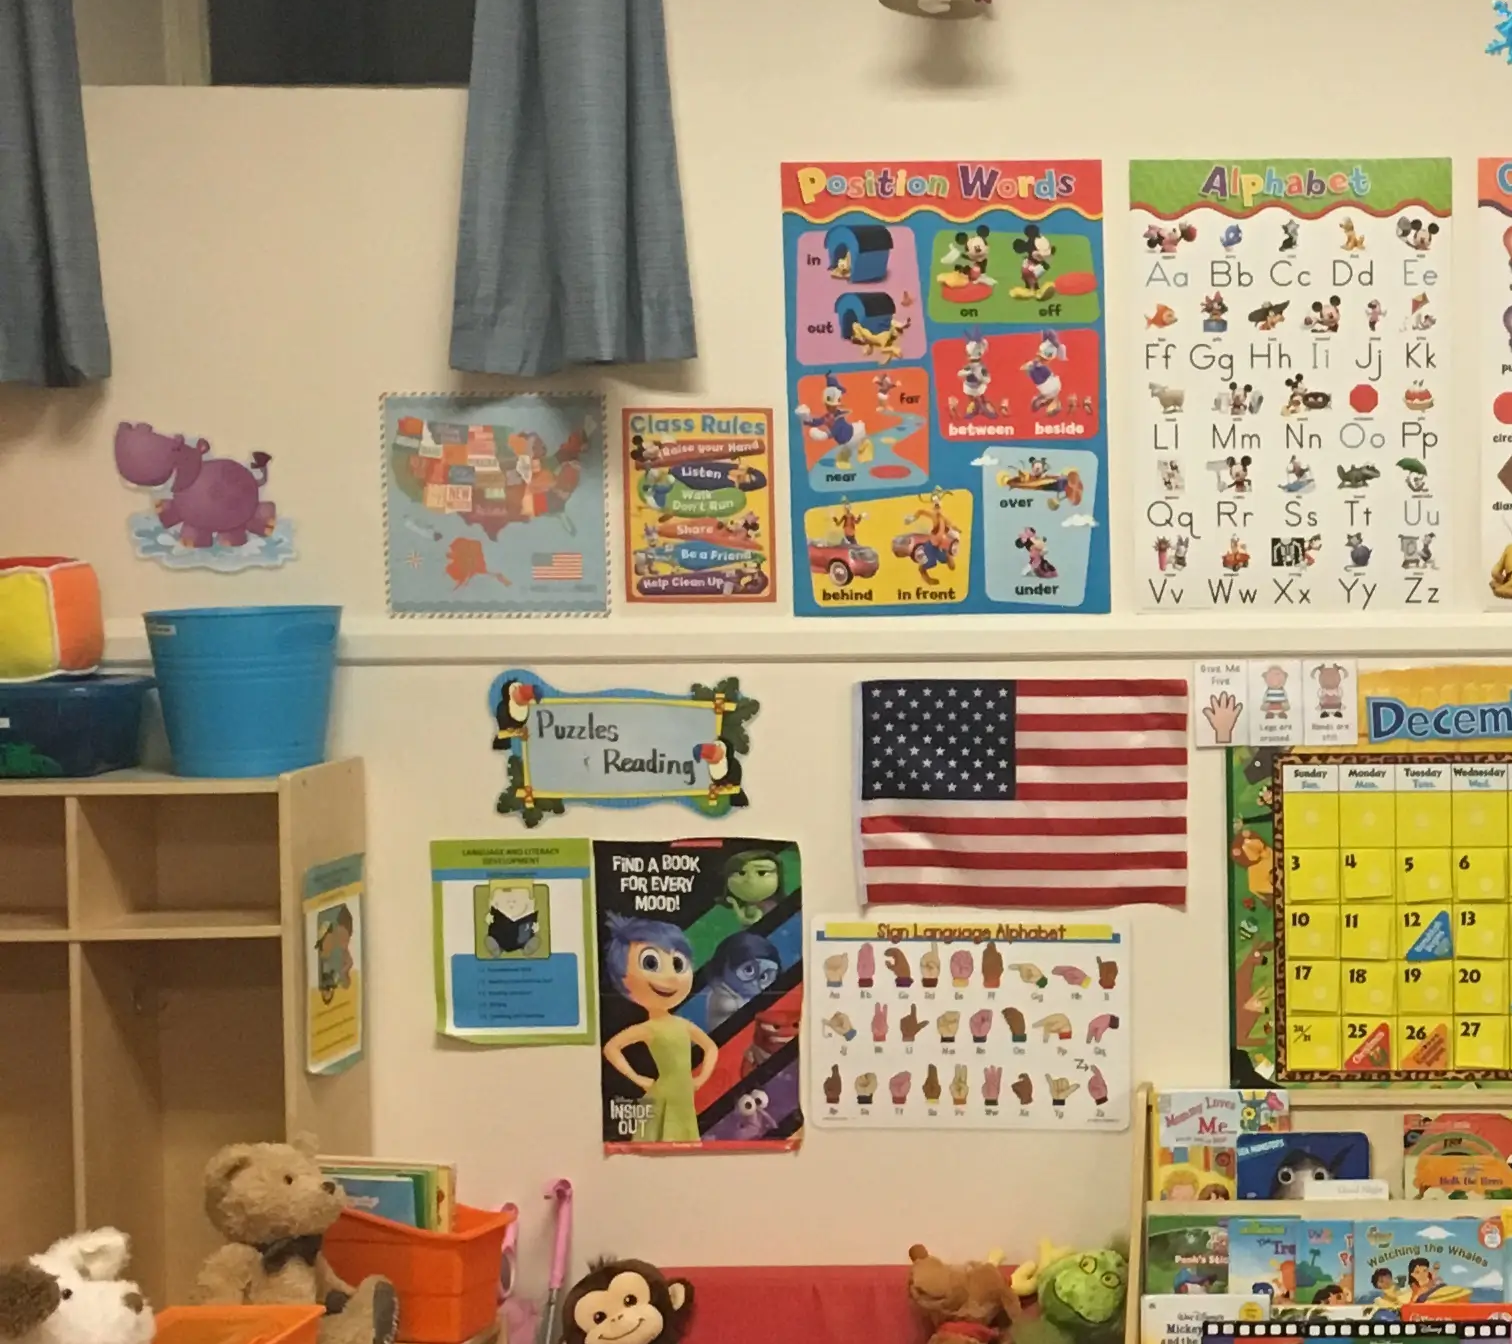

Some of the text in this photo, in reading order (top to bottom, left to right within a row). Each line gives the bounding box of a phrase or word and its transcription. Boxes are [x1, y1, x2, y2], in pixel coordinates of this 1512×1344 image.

[798, 164, 1074, 203] Position Words
[1202, 164, 1371, 206] Alphabet
[807, 253, 820, 265] in
[1145, 263, 1189, 288] Aa
[1212, 261, 1254, 287] Bb
[960, 306, 978, 317] on
[1039, 303, 1061, 317] off
[807, 322, 833, 333] out
[1190, 343, 1234, 379] Gg
[1405, 342, 1437, 368] Kk
[899, 392, 921, 403] far
[631, 415, 765, 435] Class Rules
[948, 422, 1014, 436] between
[1034, 422, 1084, 435] beside
[663, 441, 759, 456] Raise your Hand
[682, 467, 721, 479] Listen
[826, 472, 856, 482] near
[682, 490, 711, 500] Walk
[672, 499, 733, 512] Don't Run
[1000, 498, 1033, 509] over
[1217, 502, 1253, 527] Rr
[677, 524, 713, 534] Share
[681, 549, 751, 561] Be a Friend
[644, 576, 724, 589] Help Clean Up
[1015, 582, 1059, 596] under
[822, 588, 872, 602] behind
[898, 587, 956, 601] in front
[537, 710, 618, 742] Puzzles
[604, 749, 696, 785] Reading
[1294, 769, 1327, 779] Sunday
[1349, 769, 1386, 778] Monday
[1404, 768, 1442, 778] Tuesday
[1454, 768, 1505, 777] Wednesday
[613, 855, 700, 873] FIND A BOOK
[620, 875, 694, 893] FOR EVERY
[635, 895, 680, 912] MOOD!
[1404, 913, 1421, 926] 12
[878, 924, 1066, 944] Sign Language Alphabet
[1459, 970, 1480, 983] 20
[1348, 1025, 1367, 1038] 25
[610, 1100, 654, 1119] INSIDE
[1165, 1096, 1236, 1127] Mommy Loves
[618, 1119, 647, 1137] OUT
[1199, 1117, 1227, 1133] Me
[1368, 1244, 1488, 1268] Watching the Whales
[1167, 1324, 1202, 1335] Mickey
